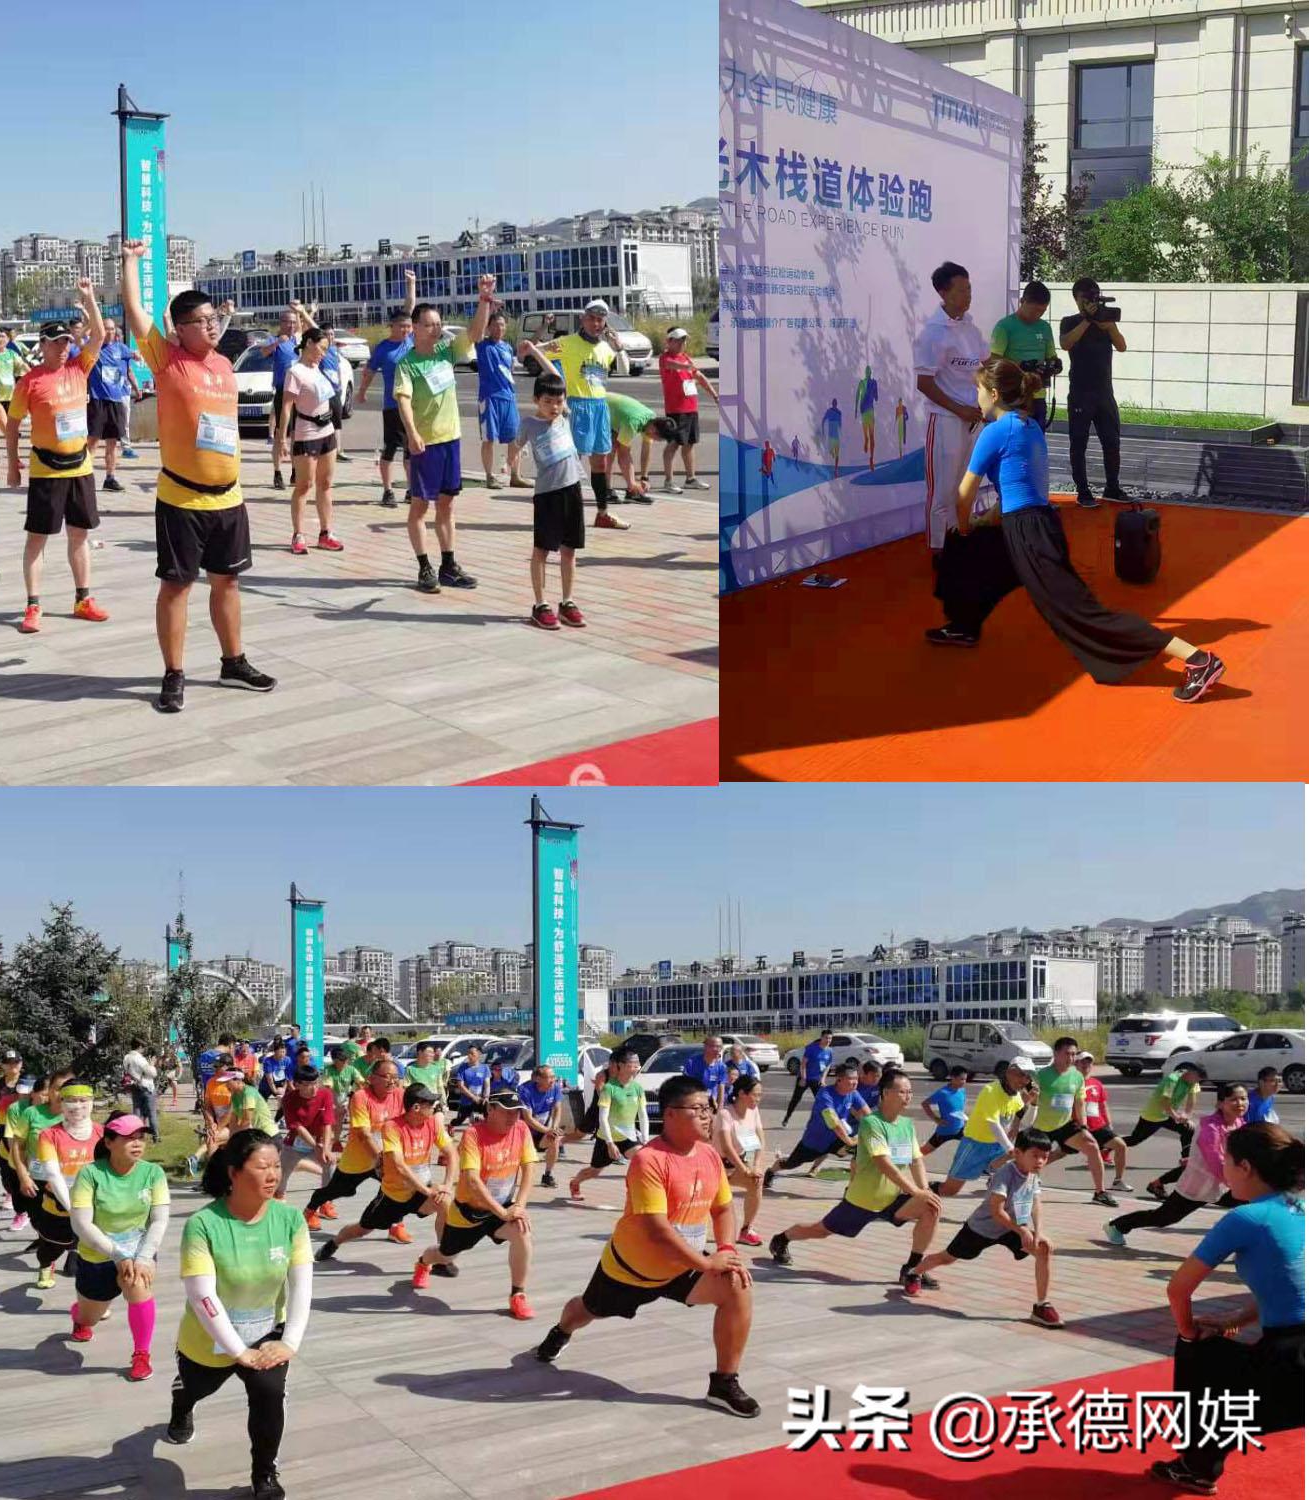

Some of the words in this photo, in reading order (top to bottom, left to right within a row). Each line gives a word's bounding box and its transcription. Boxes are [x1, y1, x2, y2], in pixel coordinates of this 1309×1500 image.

[932, 93, 979, 129] TITIAN
[758, 203, 797, 226] ROAD
[801, 212, 878, 237] EXPERIENCE
[881, 224, 904, 240] RUN
